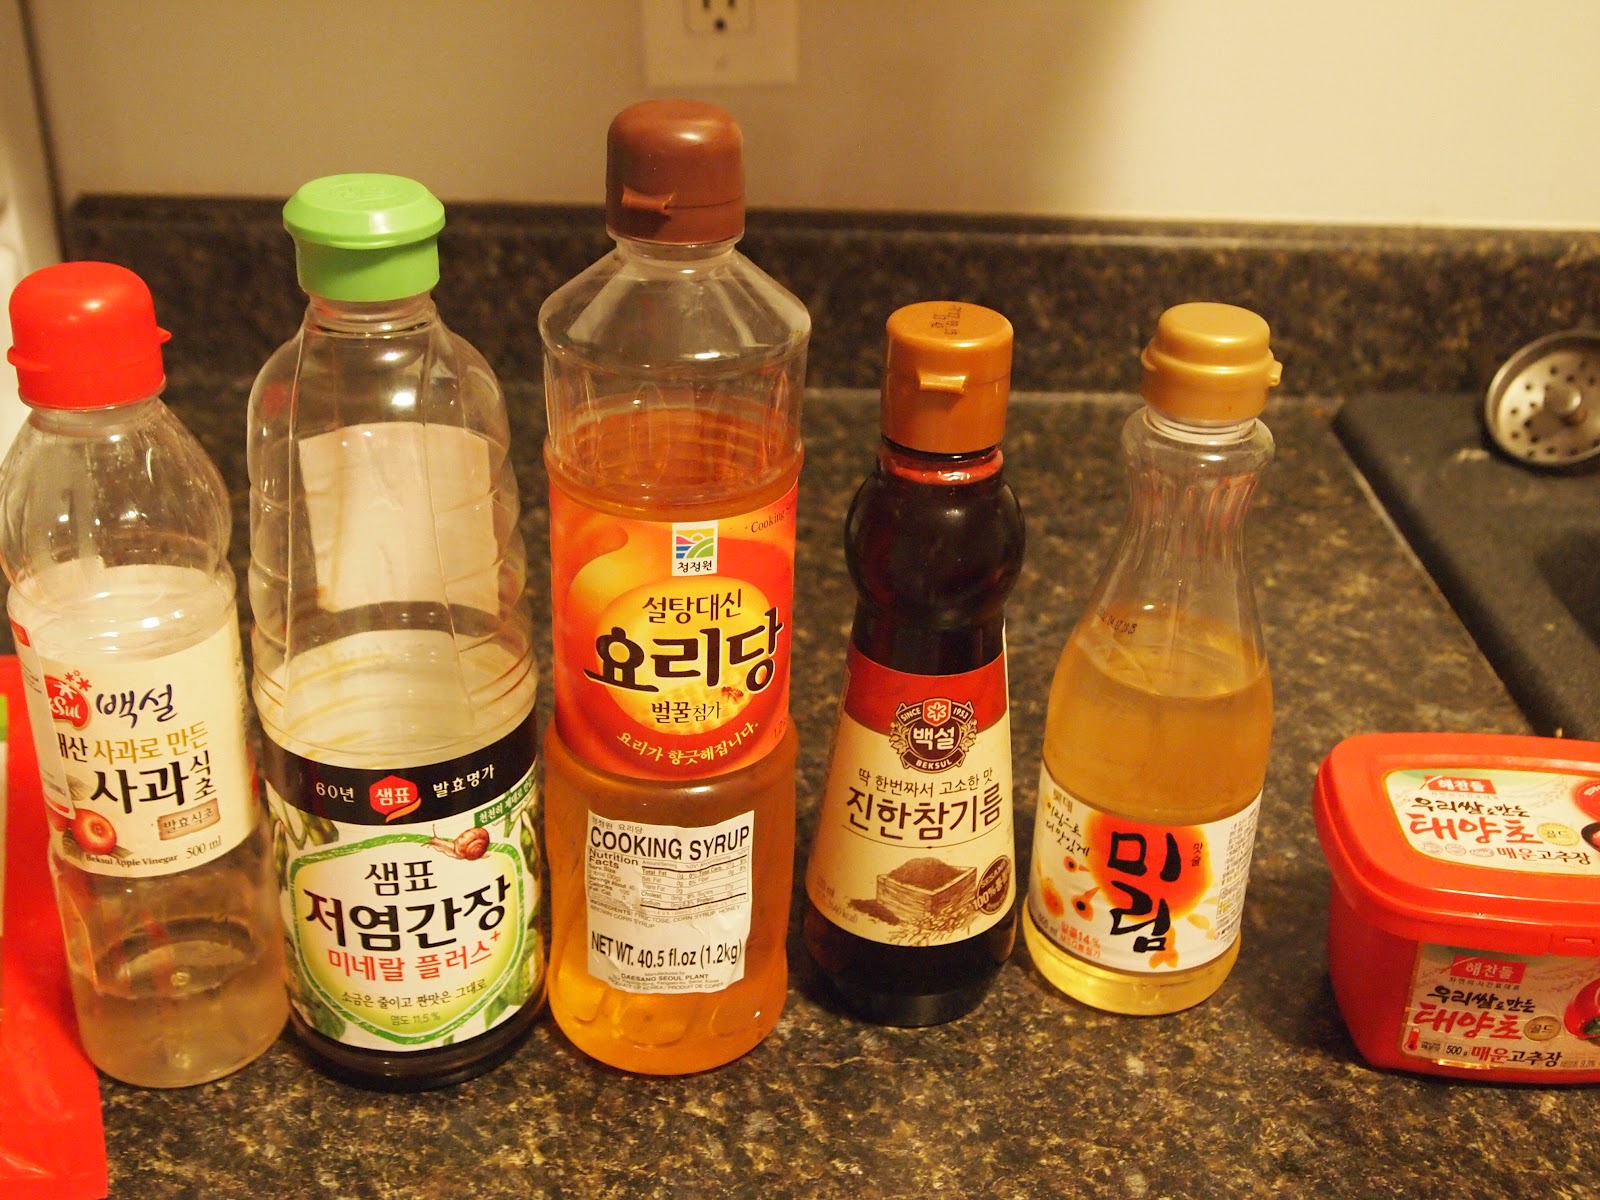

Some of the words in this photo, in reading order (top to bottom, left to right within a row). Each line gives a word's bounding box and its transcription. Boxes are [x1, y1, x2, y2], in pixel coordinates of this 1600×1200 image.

[642, 588, 742, 624] 설탕대신
[583, 606, 784, 694] 요리당
[95, 684, 178, 729] 백설
[901, 707, 922, 722] SINCE
[952, 707, 970, 720] 1953
[93, 738, 163, 765] 사과로
[166, 720, 209, 756] 만든
[617, 731, 664, 762] 요리가
[913, 726, 955, 751] 백설
[916, 757, 953, 771] BEKSUL
[315, 782, 355, 803] 60년
[374, 786, 411, 806] 샘표
[433, 764, 495, 799] 발효명가
[875, 774, 934, 798] 한번짜서
[939, 773, 980, 796] 고소한
[983, 766, 994, 785] 맛
[847, 781, 1003, 841] 진한참기름
[590, 826, 683, 861] COOKING
[689, 825, 750, 862] SYRUP
[1405, 812, 1544, 845] 태양초
[116, 855, 141, 868] Apple
[142, 853, 178, 866] Vinegar
[187, 843, 207, 860] 500
[209, 835, 223, 851] ml
[589, 848, 639, 866] Nutrition
[589, 856, 620, 870] Facts
[365, 860, 438, 897] 샘표
[303, 875, 511, 951] 저염간장
[327, 949, 406, 982] 미네랄
[591, 930, 614, 957] NET
[615, 940, 635, 966] WT.
[637, 948, 665, 969] 40.5
[668, 947, 697, 968] fl.oz
[700, 937, 743, 970] (1.2kg)
[455, 978, 487, 999] 그대로
[621, 973, 657, 982] DAESANG
[685, 973, 709, 981] PLANT
[1413, 1001, 1523, 1040] 태양초
